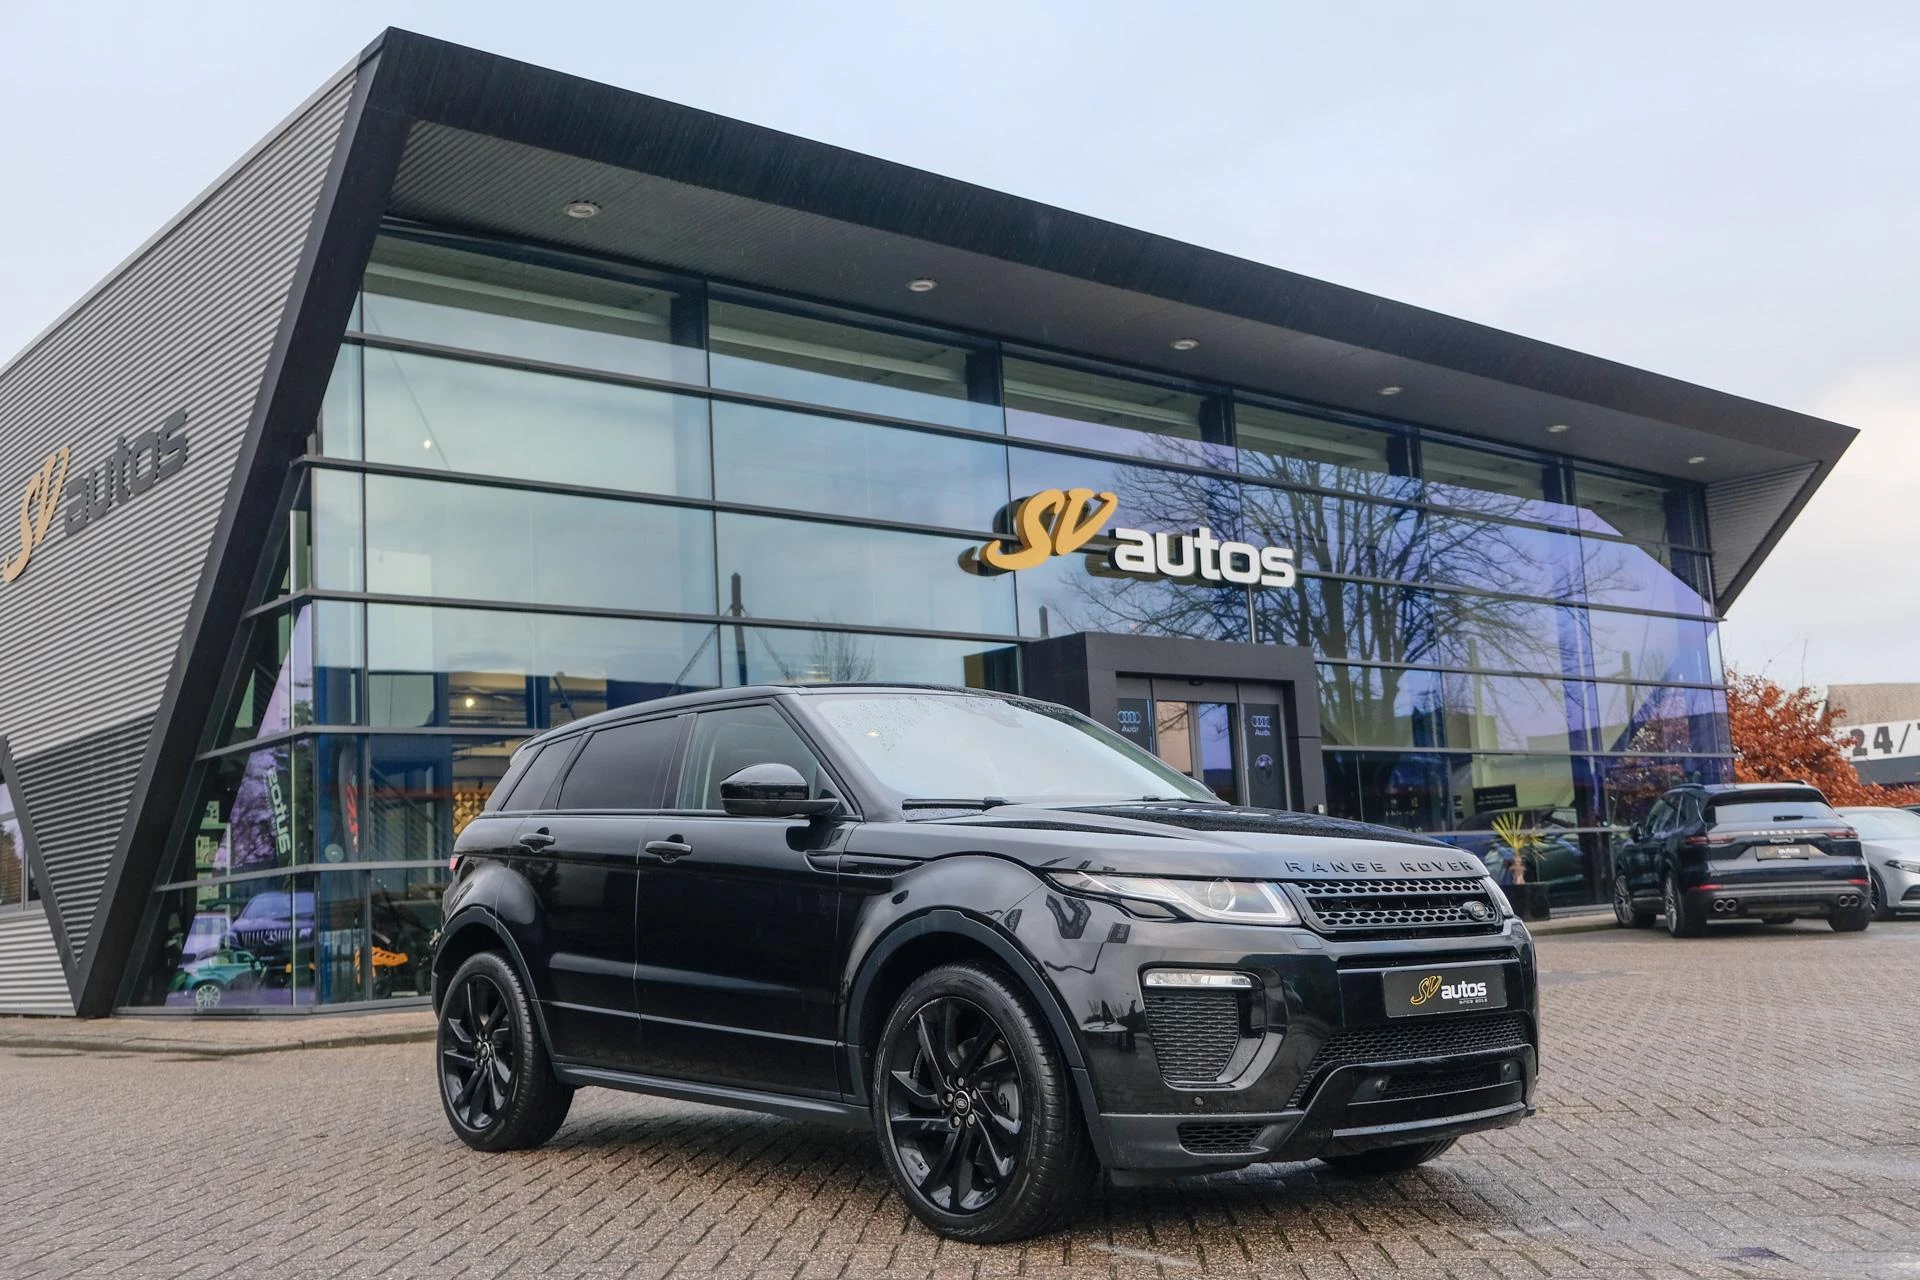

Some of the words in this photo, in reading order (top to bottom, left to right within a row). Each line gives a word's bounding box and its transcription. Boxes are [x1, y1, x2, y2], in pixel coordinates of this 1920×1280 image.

[2, 446, 72, 583] SV
[64, 409, 187, 536] autos
[980, 487, 1119, 570] SV
[1109, 527, 1297, 588] autos
[1850, 722, 1920, 757] 24/
[1284, 861, 1388, 873] RANGE
[1400, 860, 1474, 872] ROVER
[1410, 975, 1442, 1005] SV
[1441, 981, 1487, 999] autos
